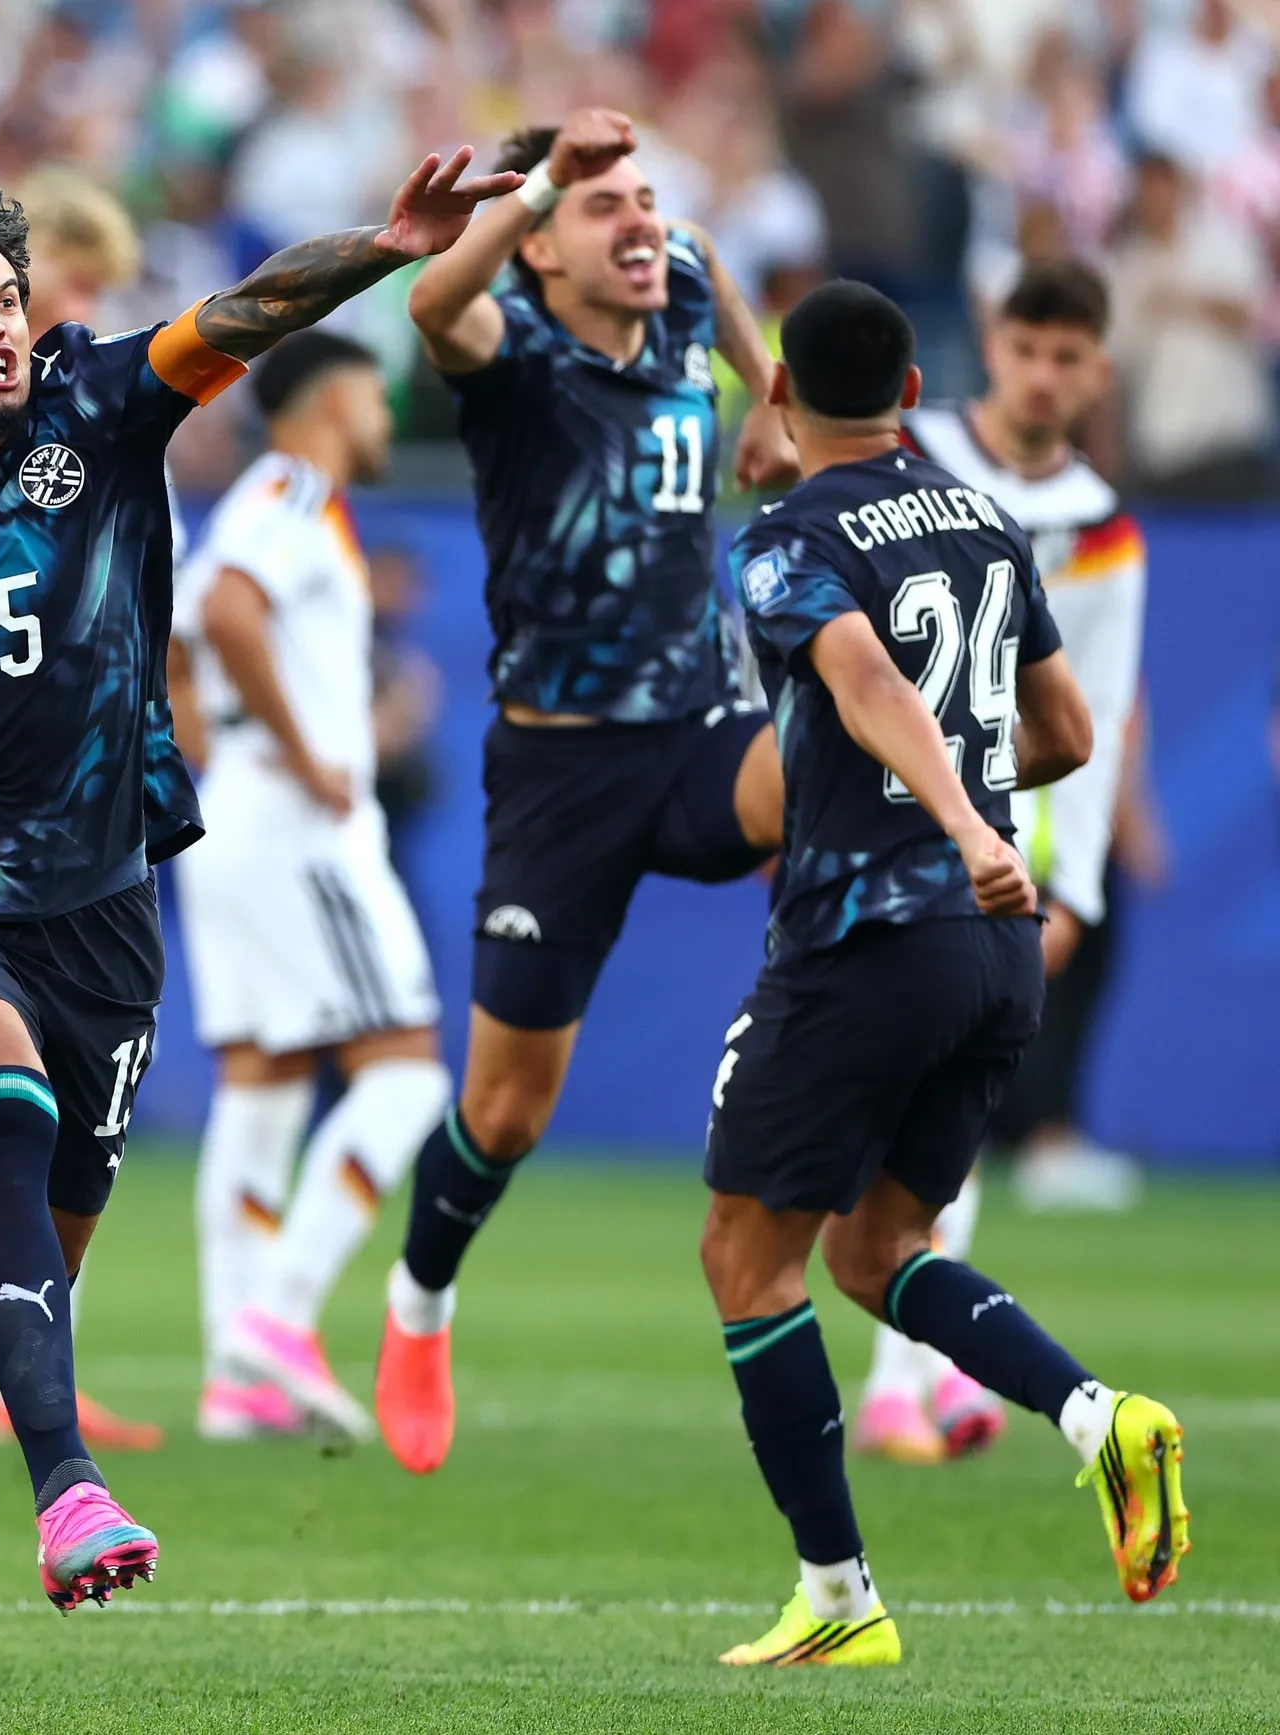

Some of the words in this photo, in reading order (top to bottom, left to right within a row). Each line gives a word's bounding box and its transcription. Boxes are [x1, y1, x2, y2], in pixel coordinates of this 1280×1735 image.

[31, 449, 50, 468] APF
[651, 414, 704, 513] 11
[49, 486, 76, 505] PARAGUAY
[883, 559, 1021, 804] 24
